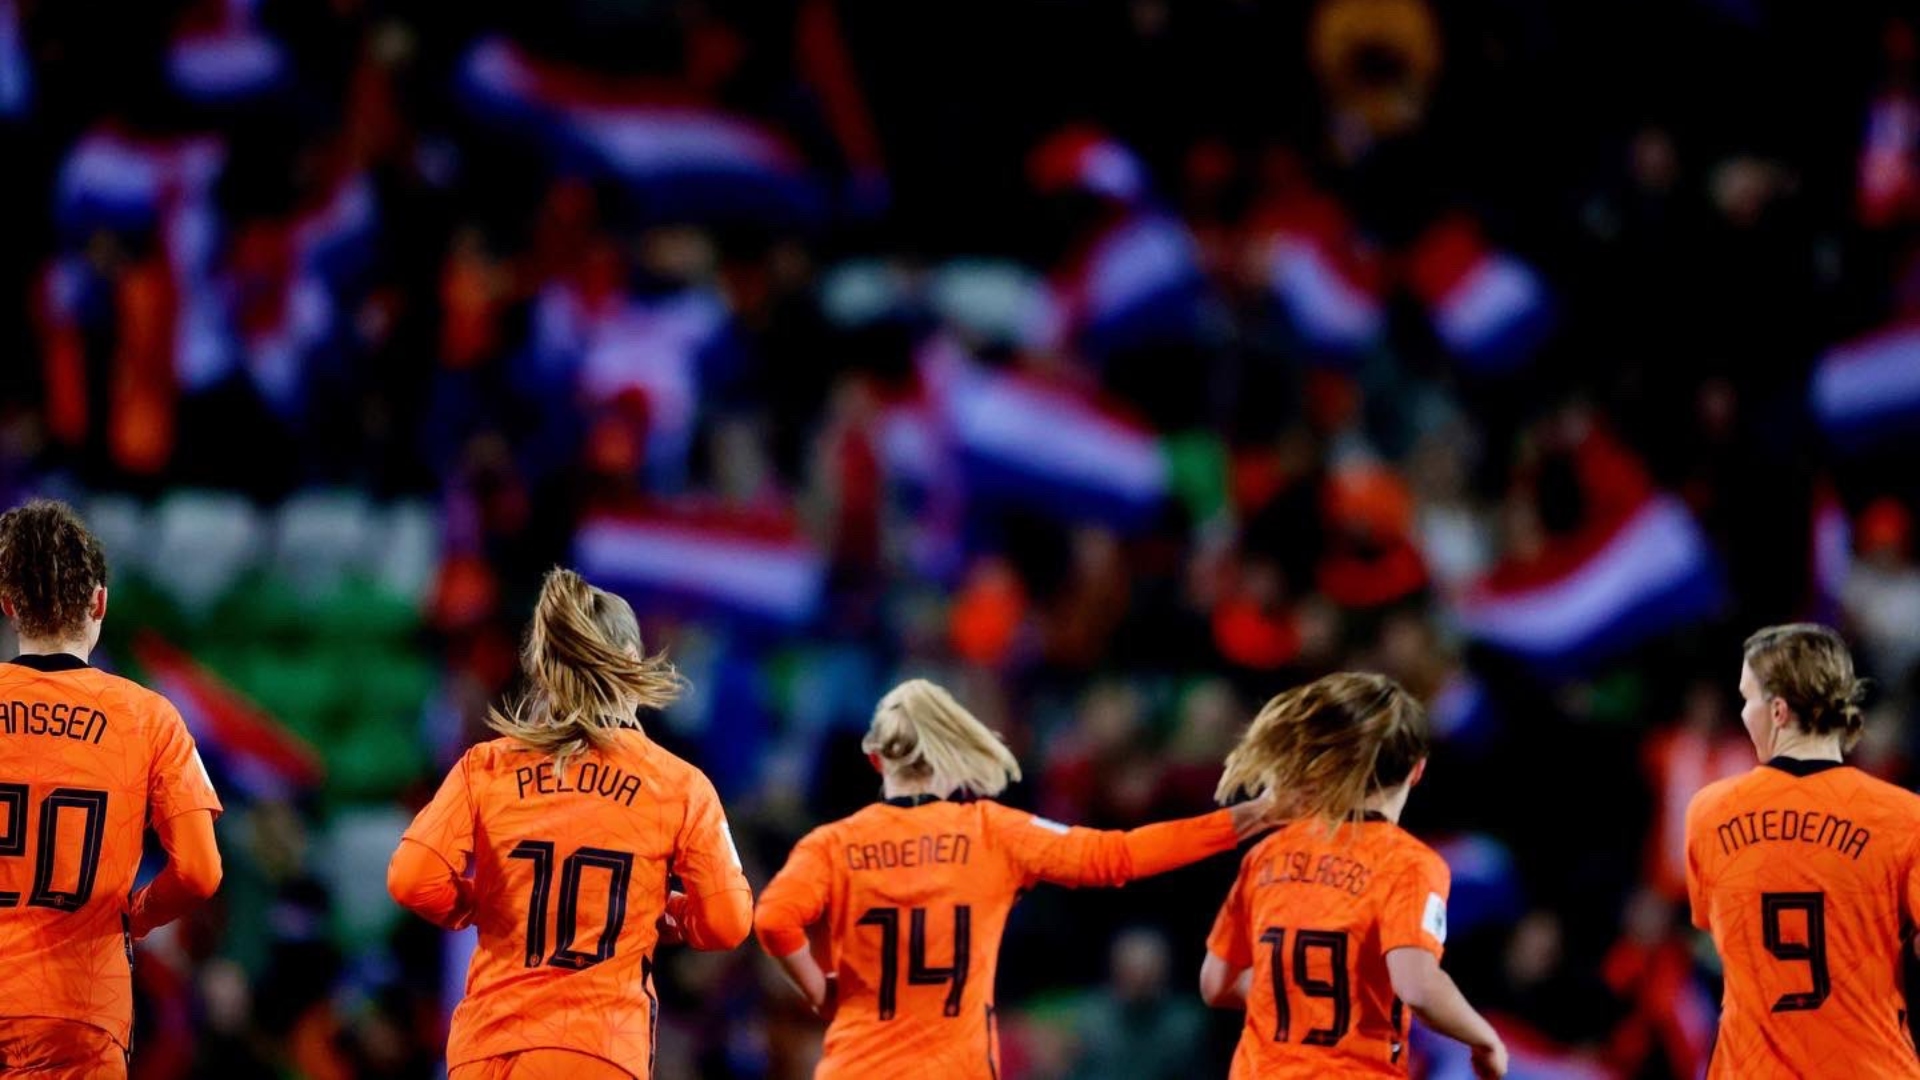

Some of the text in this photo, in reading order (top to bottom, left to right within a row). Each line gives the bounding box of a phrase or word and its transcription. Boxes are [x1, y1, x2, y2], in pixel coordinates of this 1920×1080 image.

[516, 763, 641, 806] PELOVA
[1717, 810, 1870, 860] MIEDEMA
[507, 840, 634, 969] 10
[846, 834, 970, 870] GROENEN
[856, 905, 971, 1021] 14
[1259, 927, 1349, 1046] 19
[1761, 892, 1831, 1013] 9
